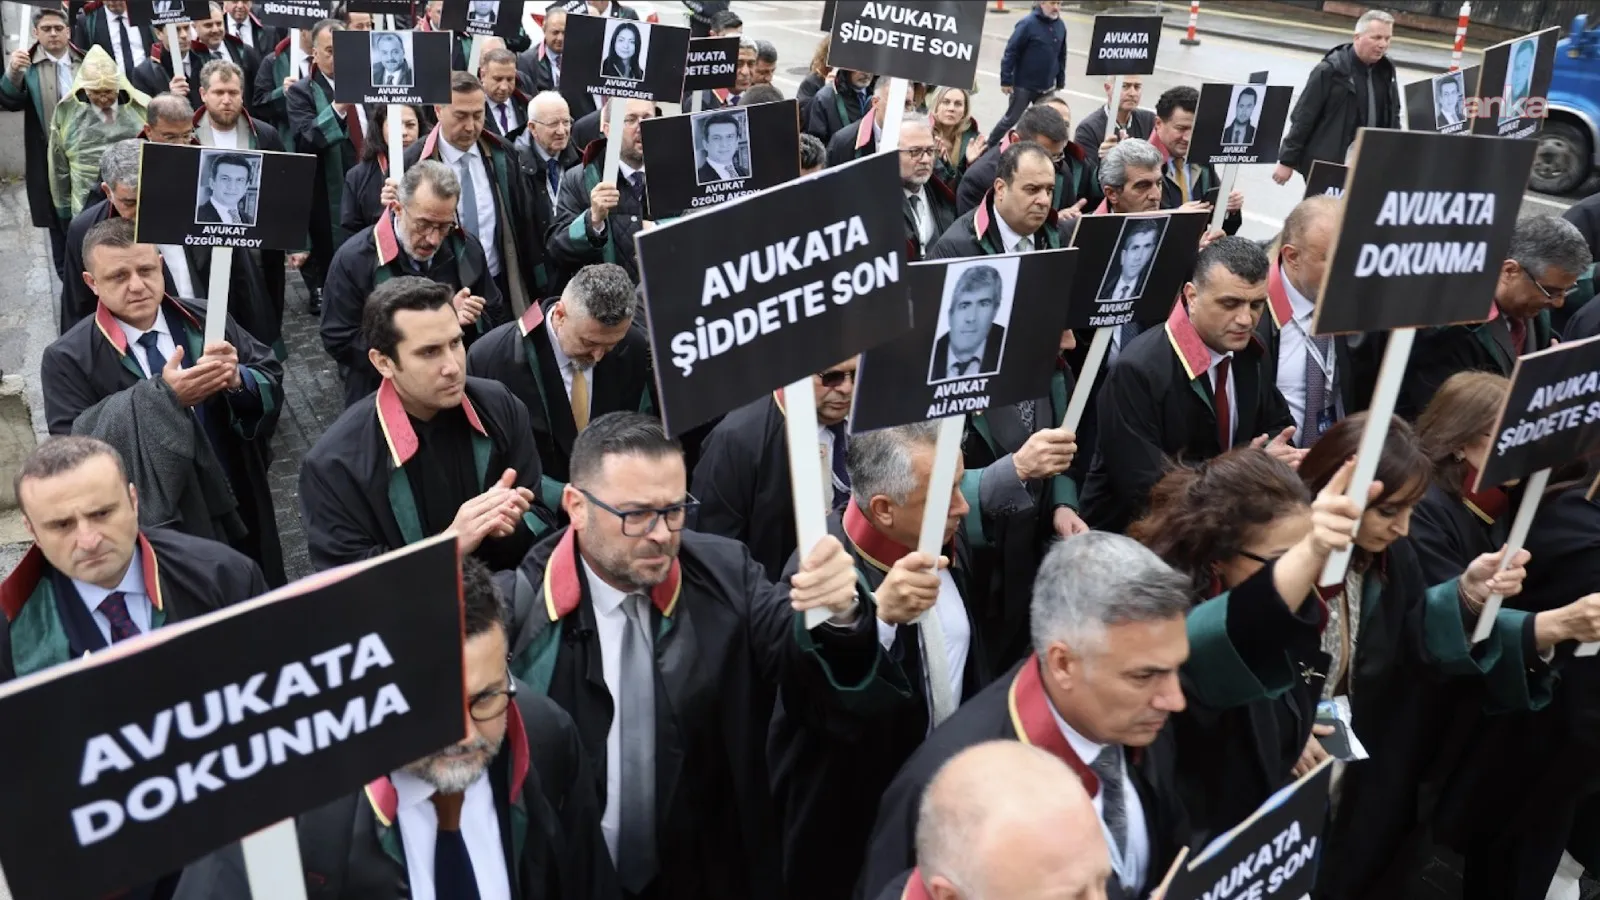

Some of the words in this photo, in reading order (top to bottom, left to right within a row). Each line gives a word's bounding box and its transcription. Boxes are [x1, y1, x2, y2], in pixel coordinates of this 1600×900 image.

[264, 2, 306, 16] ŞİDDETE
[306, 7, 329, 18] SON
[861, 1, 958, 34] AVUKATA
[839, 20, 926, 53] ŞİDDETE
[928, 38, 973, 61] SON
[1103, 31, 1149, 44] AVUKATA
[688, 50, 727, 62] UKATA
[1098, 47, 1148, 60] DOKUNMA
[711, 63, 735, 75] SON
[377, 87, 409, 95] AVUKAT
[605, 79, 638, 89] AVUKAT
[364, 94, 391, 104] İSMAİL
[391, 96, 423, 104] AKKAYA
[586, 85, 616, 96] HATİCE
[616, 88, 654, 100] KOCAEFE
[1222, 146, 1249, 154] AVUKAT
[1237, 155, 1259, 163] POLAT
[705, 180, 746, 194] AVUKAT
[691, 193, 725, 207] ÖZGÜR
[1375, 190, 1496, 226] AVUKATA
[202, 225, 248, 236] AVUKAT
[184, 233, 223, 246] ÖZGÜR
[223, 238, 263, 248] AKSOY
[701, 215, 869, 306] AVUKATA
[1354, 241, 1488, 278] DOKUNMA
[670, 280, 826, 378] ŞİDDETE
[831, 251, 899, 306] SON
[1097, 301, 1135, 313] AVUKAT
[1088, 313, 1116, 326] TAHİR
[933, 378, 989, 399] AVUKAT
[1526, 370, 1600, 413] AVUKA
[926, 399, 948, 419] ALİ
[948, 395, 990, 413] AYDIN
[1497, 405, 1585, 456] ŞİDDETE
[79, 632, 395, 787] AVUKATA
[71, 682, 411, 848] DOKUNMA
[1194, 820, 1302, 900] VUKATA
[1267, 835, 1318, 894] SON
